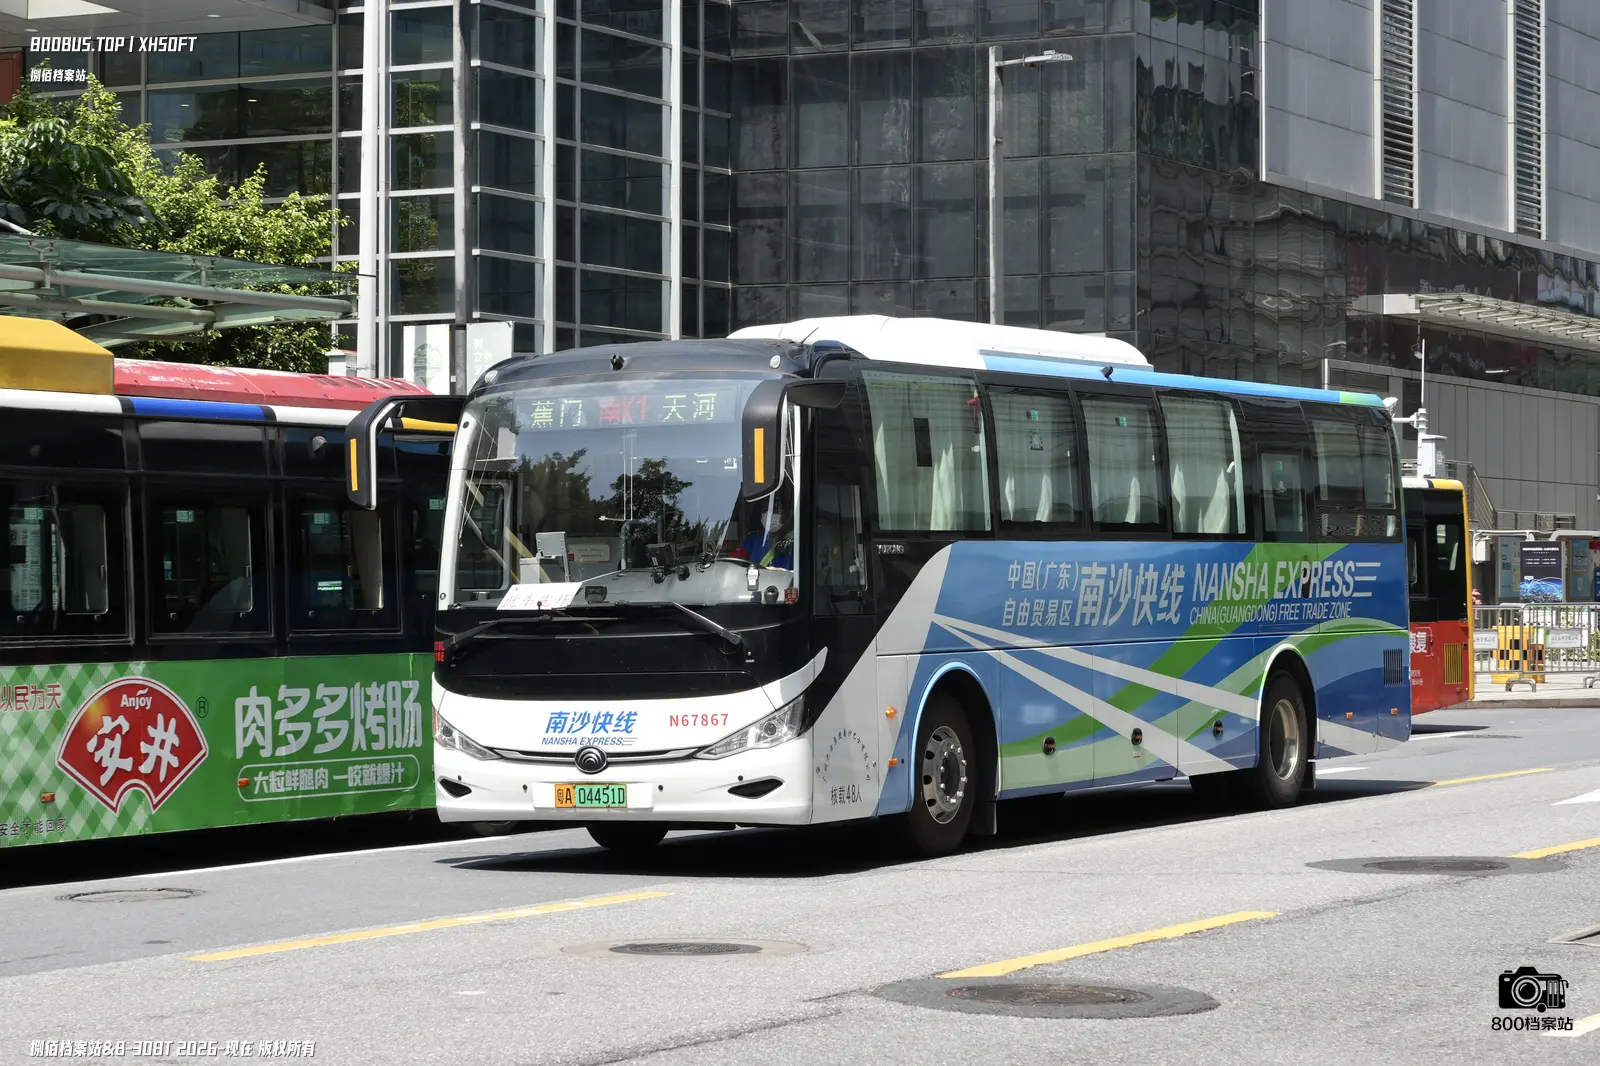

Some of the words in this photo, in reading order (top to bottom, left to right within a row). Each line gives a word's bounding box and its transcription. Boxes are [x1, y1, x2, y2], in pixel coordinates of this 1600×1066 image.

[662, 392, 717, 423] 天河
[1074, 561, 1186, 627] 南沙快线
[1192, 561, 1269, 602] NANSHA
[1273, 560, 1355, 600] EXPRESS
[1002, 598, 1074, 627] 自由贸易区
[1279, 603, 1301, 621] FREE
[1302, 602, 1328, 621] TRADE
[1329, 602, 1353, 619] ZONE
[120, 690, 153, 710] Anjoy
[234, 680, 423, 760] 肉多多烤肠
[545, 711, 639, 734] 南沙快线
[669, 713, 729, 727] N67867
[87, 713, 180, 787] 安井
[541, 736, 577, 746] NANSHA
[579, 736, 624, 746] EXPRESS
[254, 767, 329, 794] 大粒鲜腿肉
[333, 762, 406, 788] 一咬就爆汁
[830, 783, 863, 806] 核载48人
